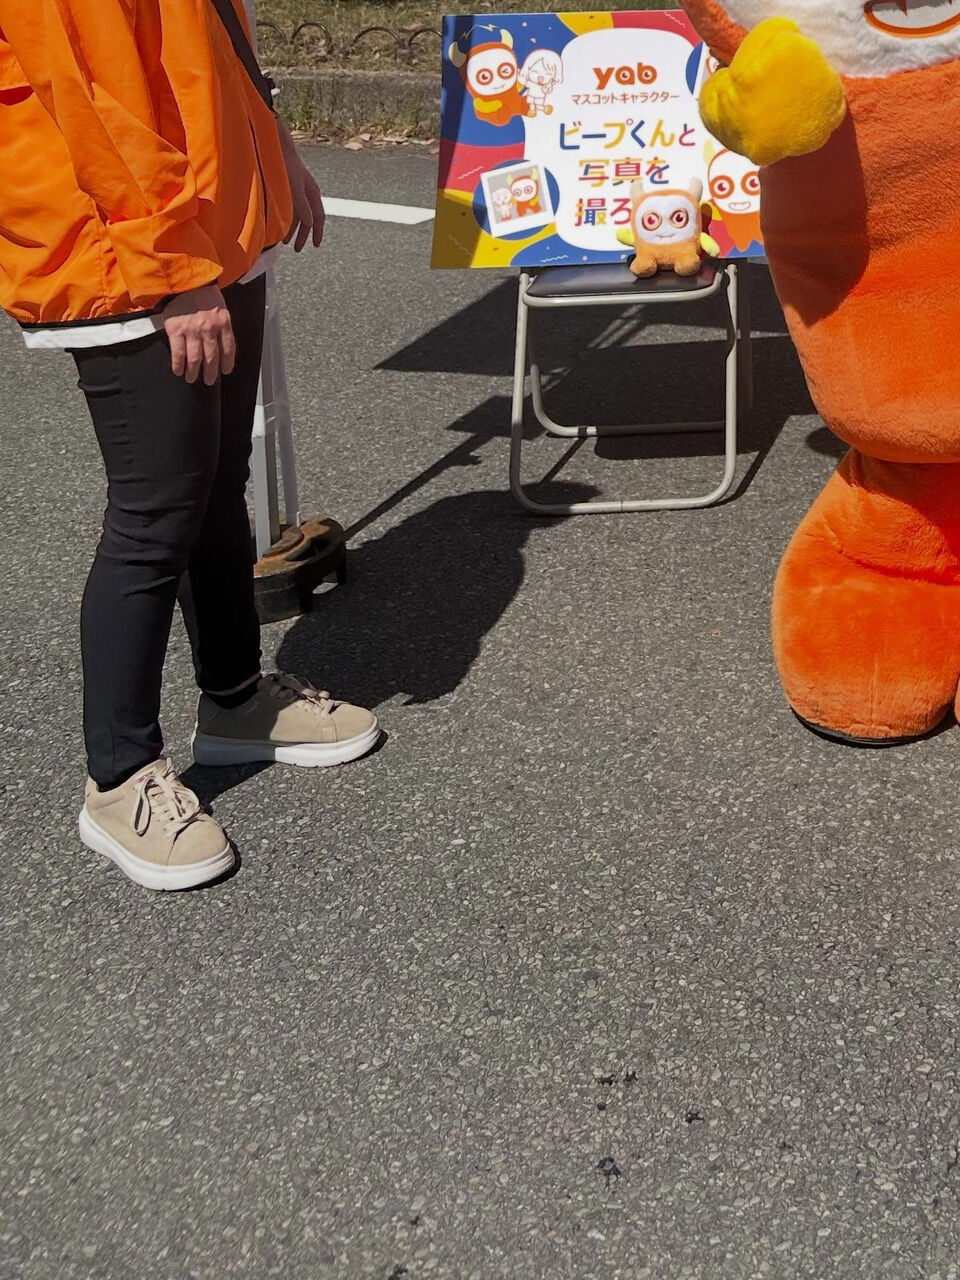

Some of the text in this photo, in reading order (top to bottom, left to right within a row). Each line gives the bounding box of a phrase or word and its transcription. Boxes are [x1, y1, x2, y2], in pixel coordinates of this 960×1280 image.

[592, 62, 658, 90] yab
[571, 92, 681, 105] マスコットキャラクター
[559, 118, 696, 150] ビープくんと
[578, 156, 670, 188] 写真を
